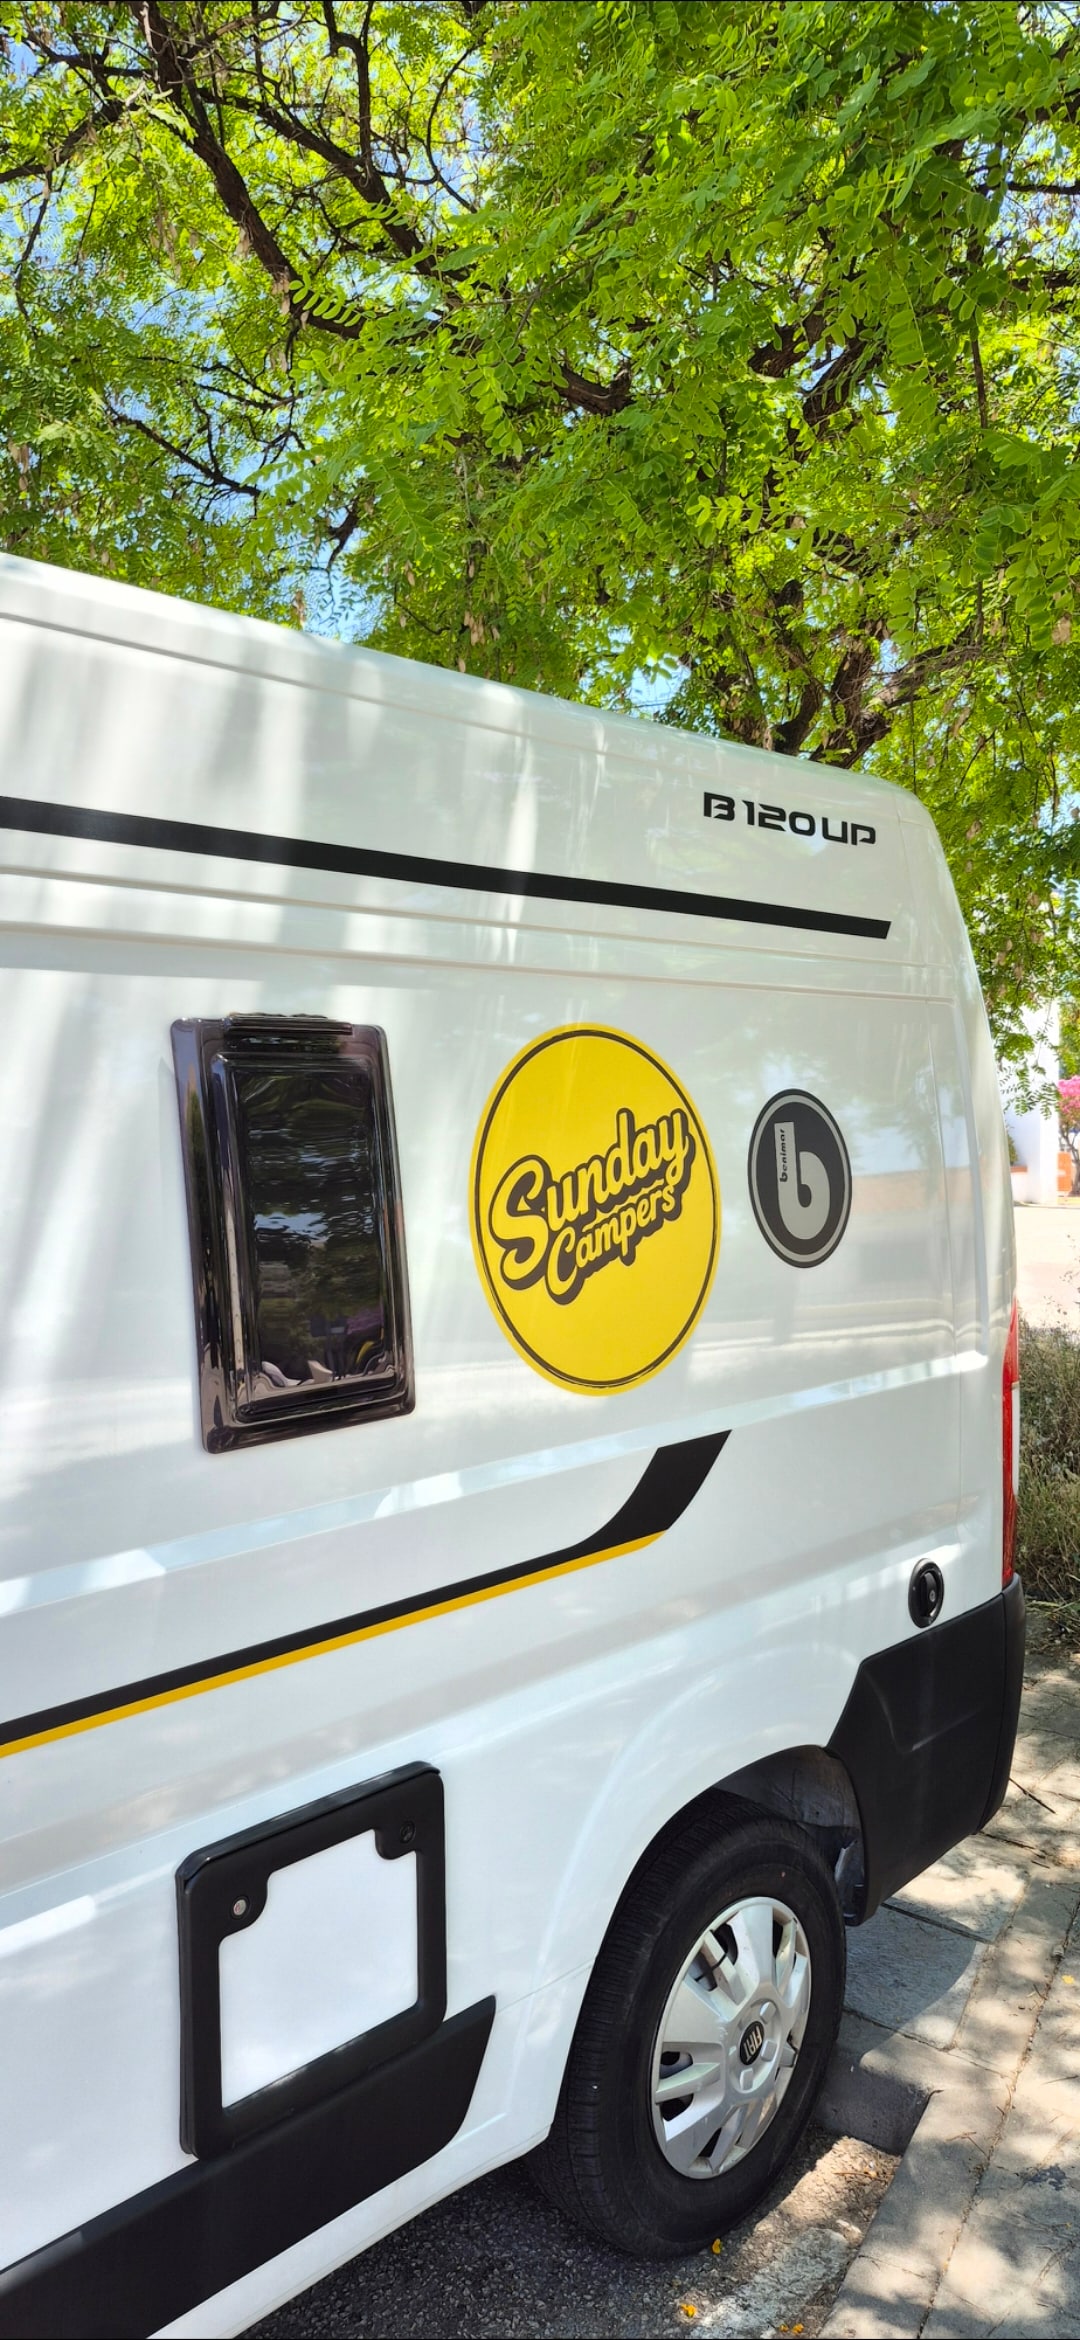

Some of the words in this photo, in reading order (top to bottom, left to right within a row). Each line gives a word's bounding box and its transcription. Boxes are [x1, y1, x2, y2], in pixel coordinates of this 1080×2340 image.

[489, 1108, 696, 1288] Sunday
[779, 1128, 788, 1183] benimar
[545, 1183, 682, 1304] Campers
[743, 2025, 763, 2062] FIAT
